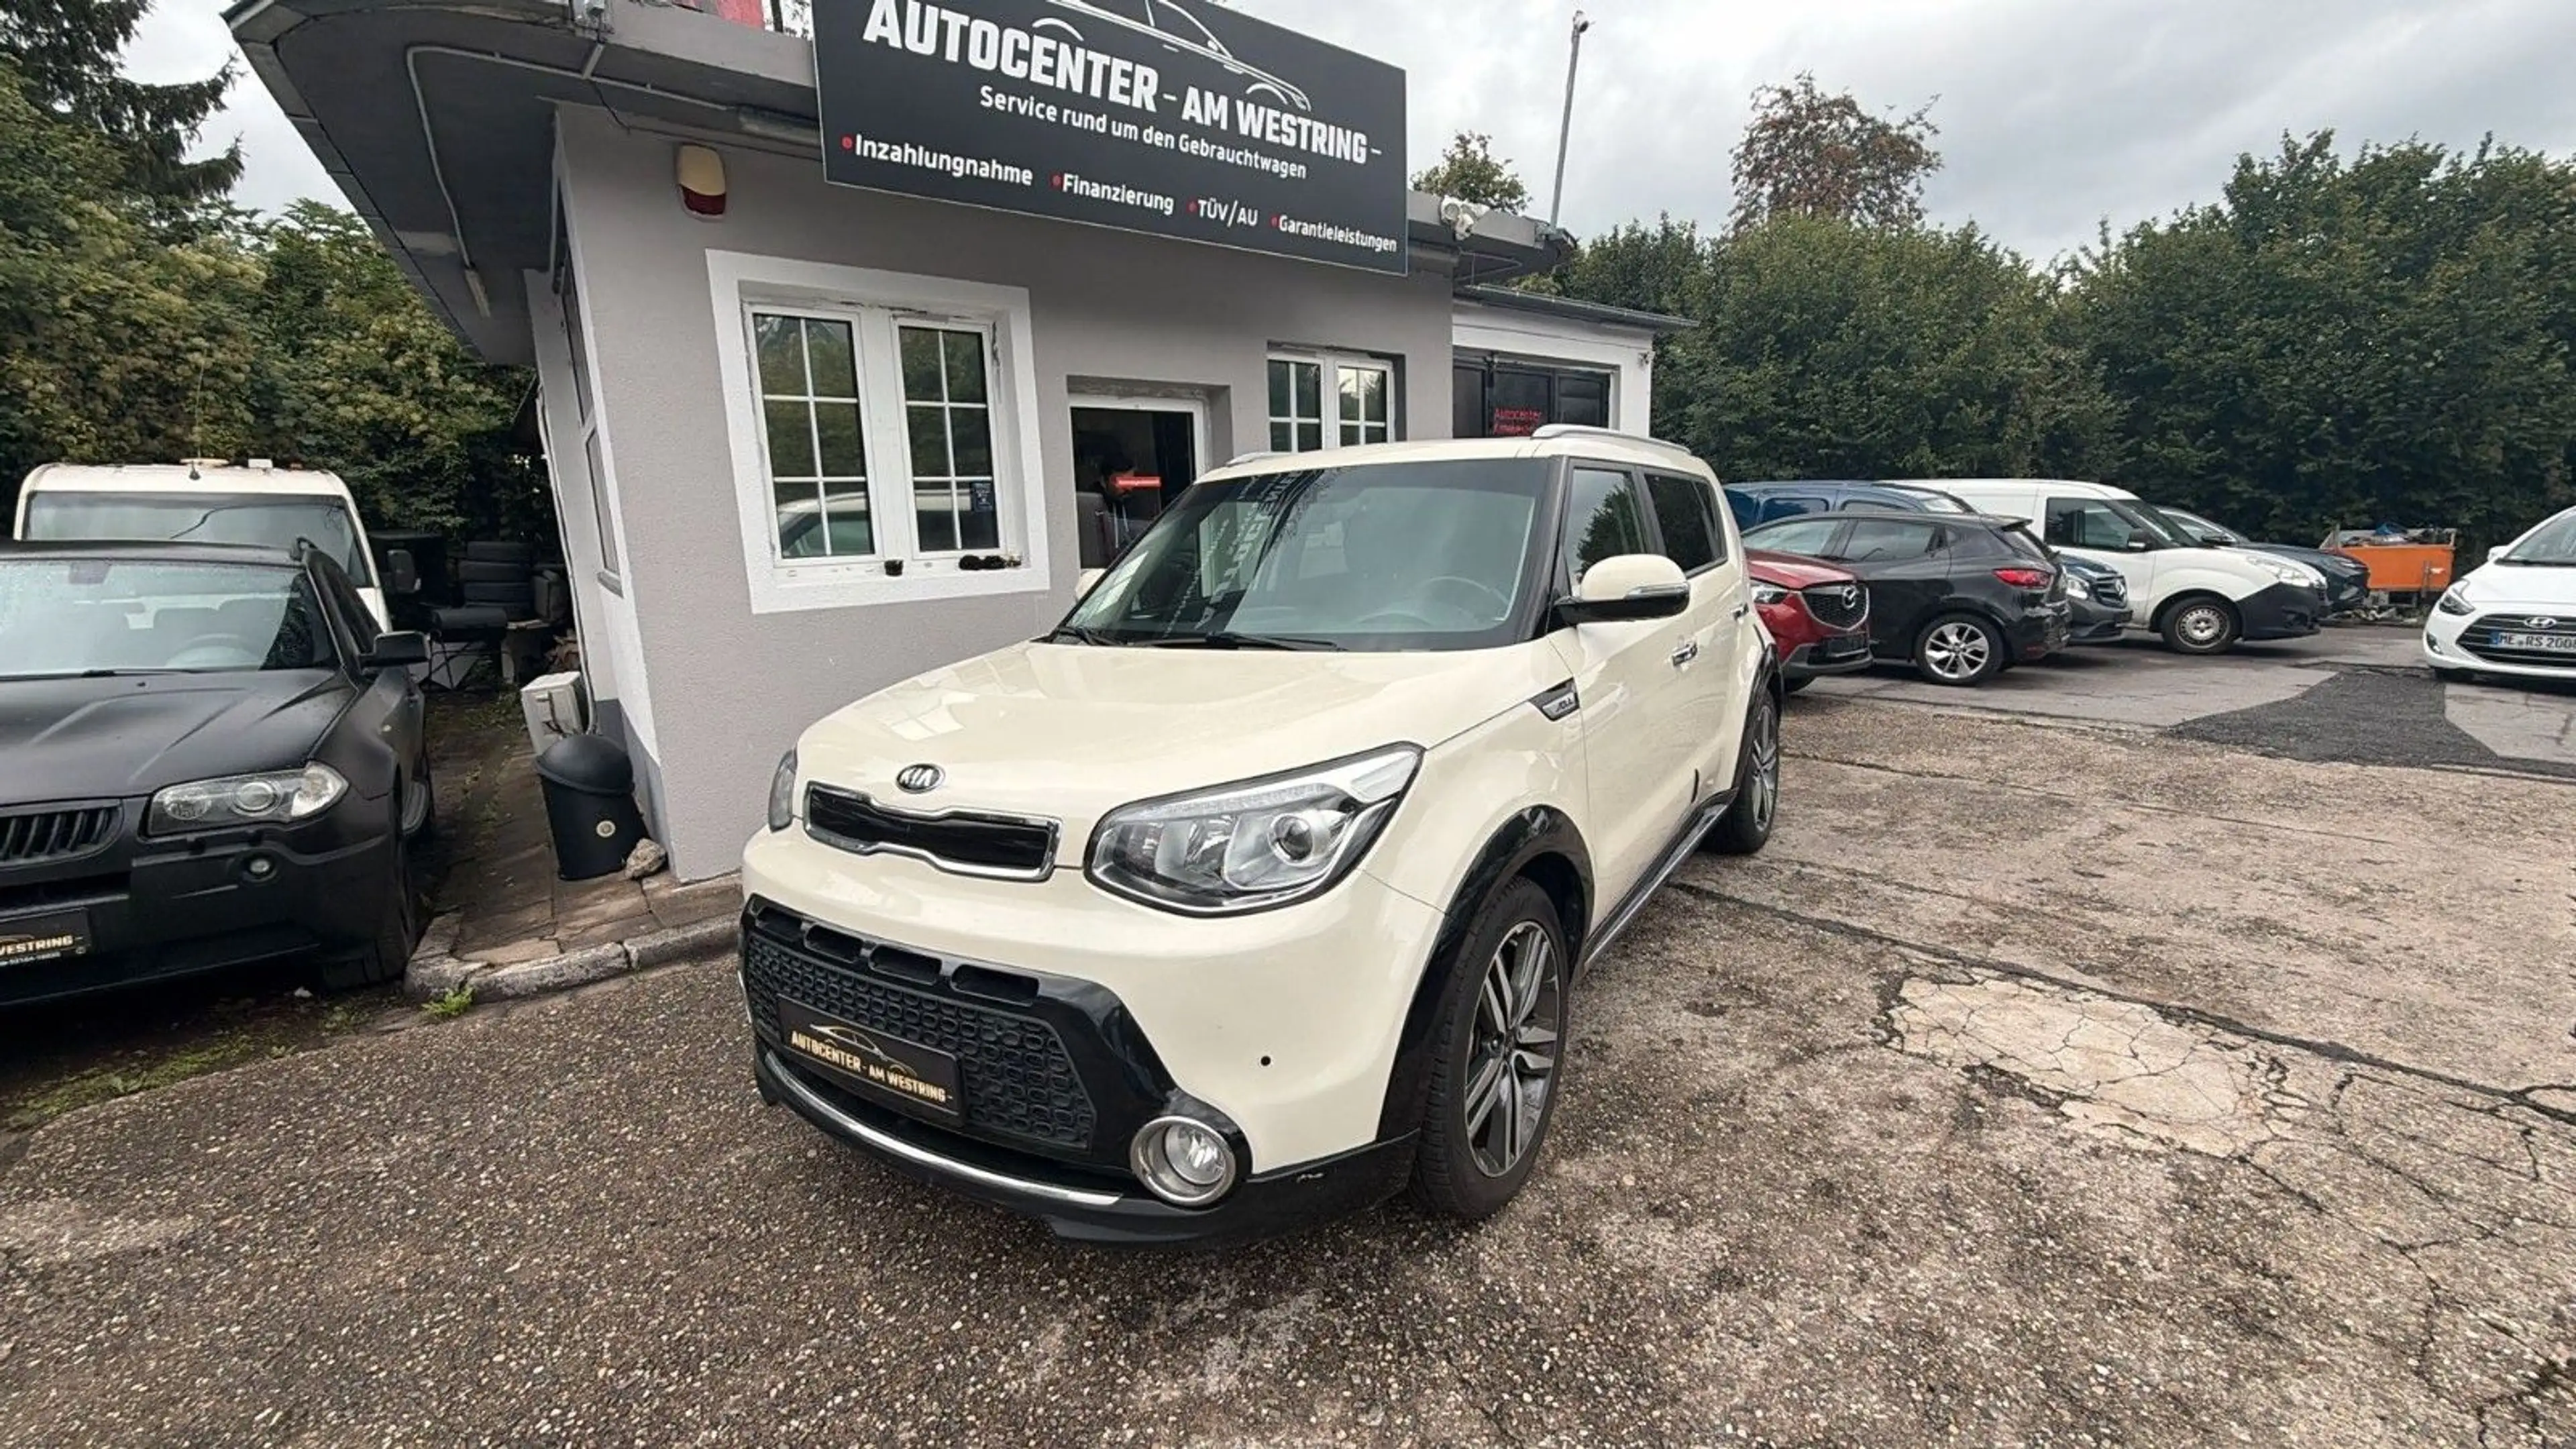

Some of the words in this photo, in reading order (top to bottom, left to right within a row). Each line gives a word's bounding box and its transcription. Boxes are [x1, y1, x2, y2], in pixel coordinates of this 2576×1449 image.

[863, 0, 1159, 113] AUTOCENTER
[1181, 85, 1228, 131] AM
[1236, 99, 1368, 164] WESTRING
[979, 85, 1057, 122] Service
[1063, 108, 1108, 133] rund
[1111, 121, 1138, 141] um
[1142, 125, 1175, 150] den
[1179, 134, 1307, 179] Gebrauchtwagen
[855, 134, 1033, 186] Inzahlungnahme
[1063, 172, 1175, 216] Finanzierung
[1197, 198, 1258, 228] TÜV/AU
[1278, 215, 1397, 253] Garantieleistungen
[2526, 636, 2543, 647] RS
[900, 768, 934, 786] KIA
[792, 1030, 861, 1073] AUTOCENTER
[869, 1064, 885, 1082] AM
[886, 1069, 946, 1103] WESTRING
